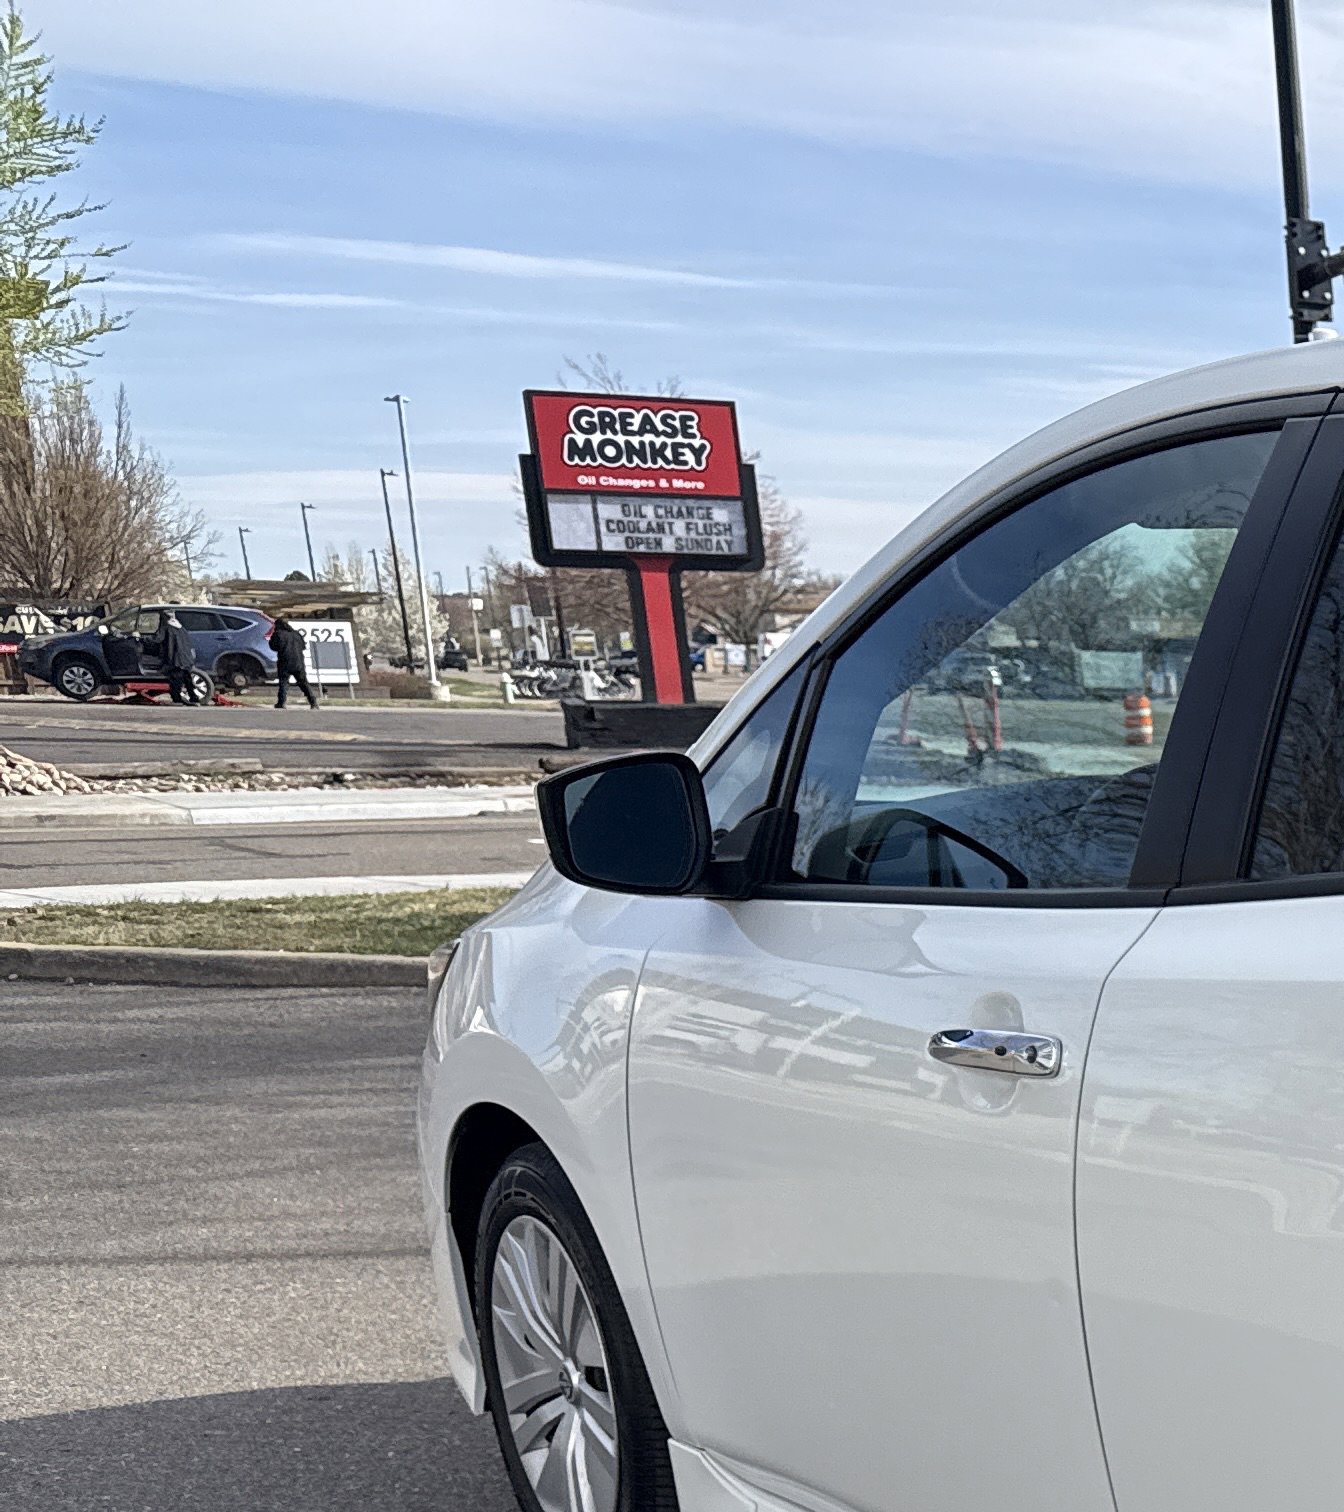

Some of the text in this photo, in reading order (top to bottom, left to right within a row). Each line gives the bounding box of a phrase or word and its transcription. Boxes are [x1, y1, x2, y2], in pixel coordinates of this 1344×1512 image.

[571, 407, 699, 440] GREASE
[566, 435, 708, 468] MONKEY
[577, 474, 706, 490] Oil Changes & More
[621, 503, 714, 521] OIL CHANGE
[605, 519, 733, 538] COOLANT FLUSH
[624, 535, 735, 553] OPEN SUNDAY
